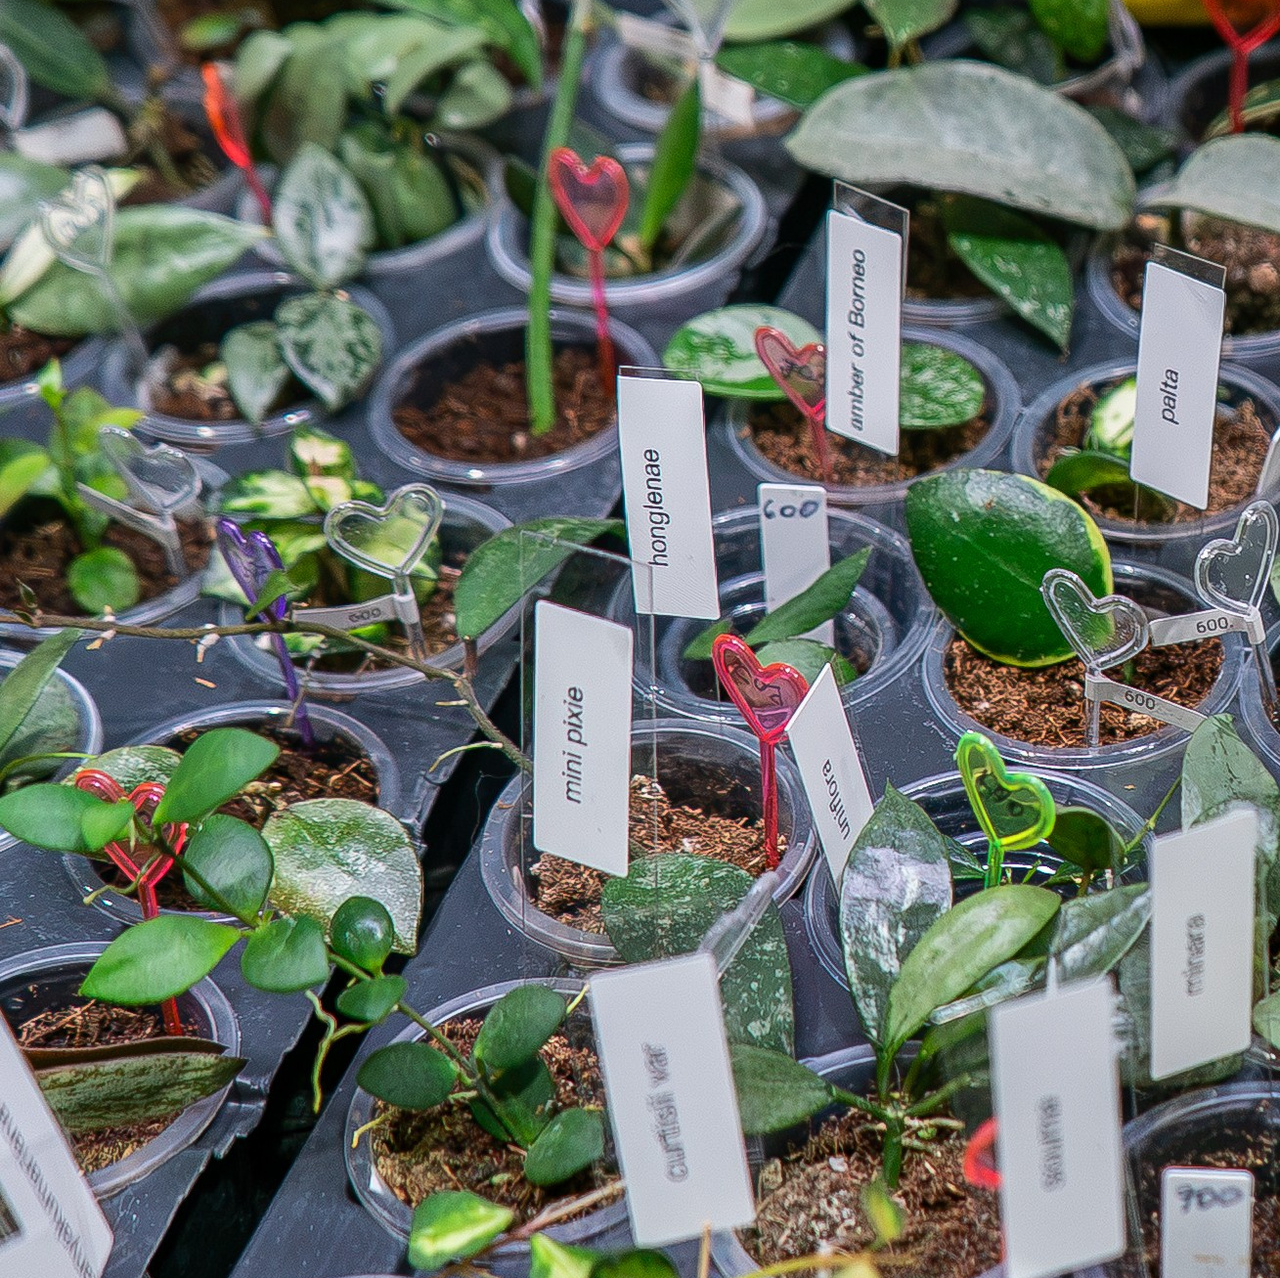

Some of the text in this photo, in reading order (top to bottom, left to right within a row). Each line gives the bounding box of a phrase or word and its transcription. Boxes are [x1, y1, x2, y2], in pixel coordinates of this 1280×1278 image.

[847, 249, 866, 431] amber of Borneo
[1159, 368, 1180, 425] palta
[643, 448, 671, 567] honglenae
[763, 498, 820, 521] 600
[1124, 689, 1156, 711] 600
[564, 685, 588, 804] mini pixie
[822, 758, 851, 841] uniflora
